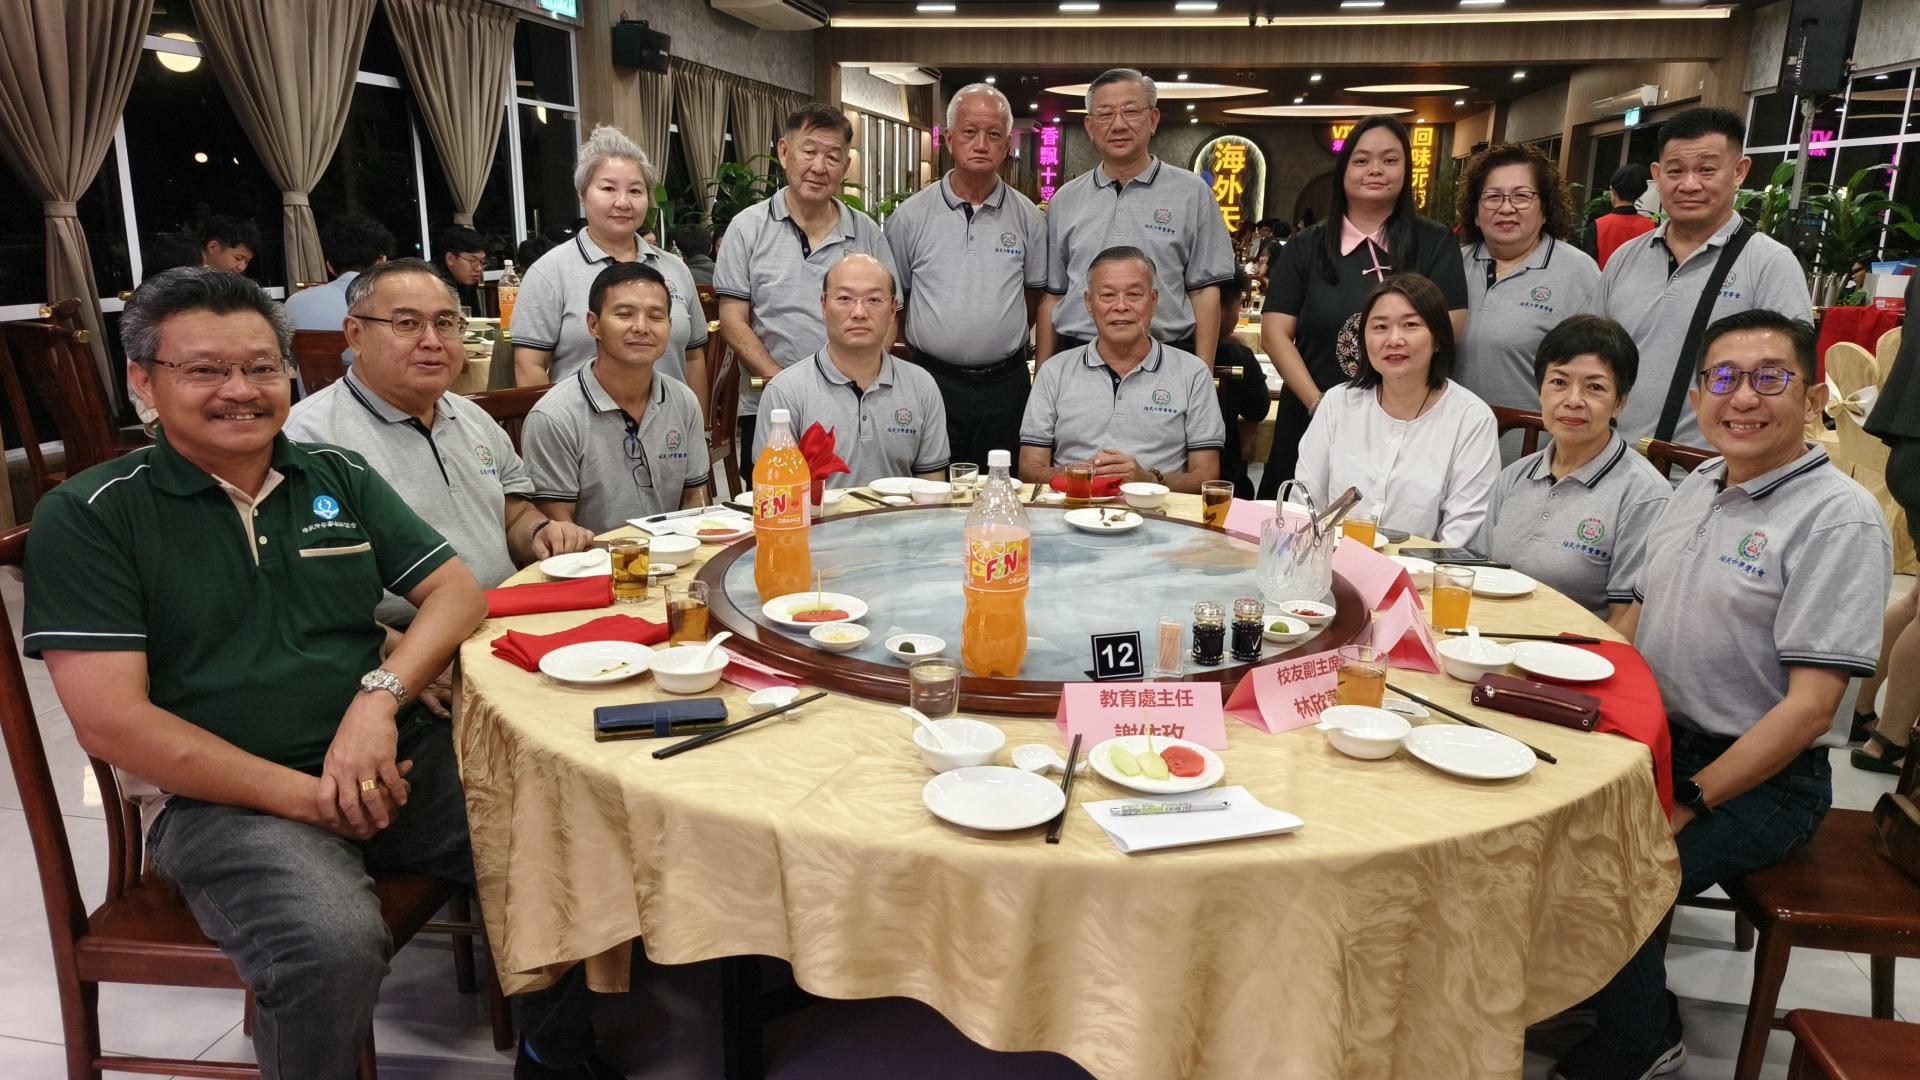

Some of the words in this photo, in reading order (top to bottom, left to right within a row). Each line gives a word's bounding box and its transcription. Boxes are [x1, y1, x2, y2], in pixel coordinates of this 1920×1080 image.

[1101, 643, 1135, 668] 12
[1277, 655, 1341, 686] 校友副主席
[1100, 688, 1194, 708] 教育處主任
